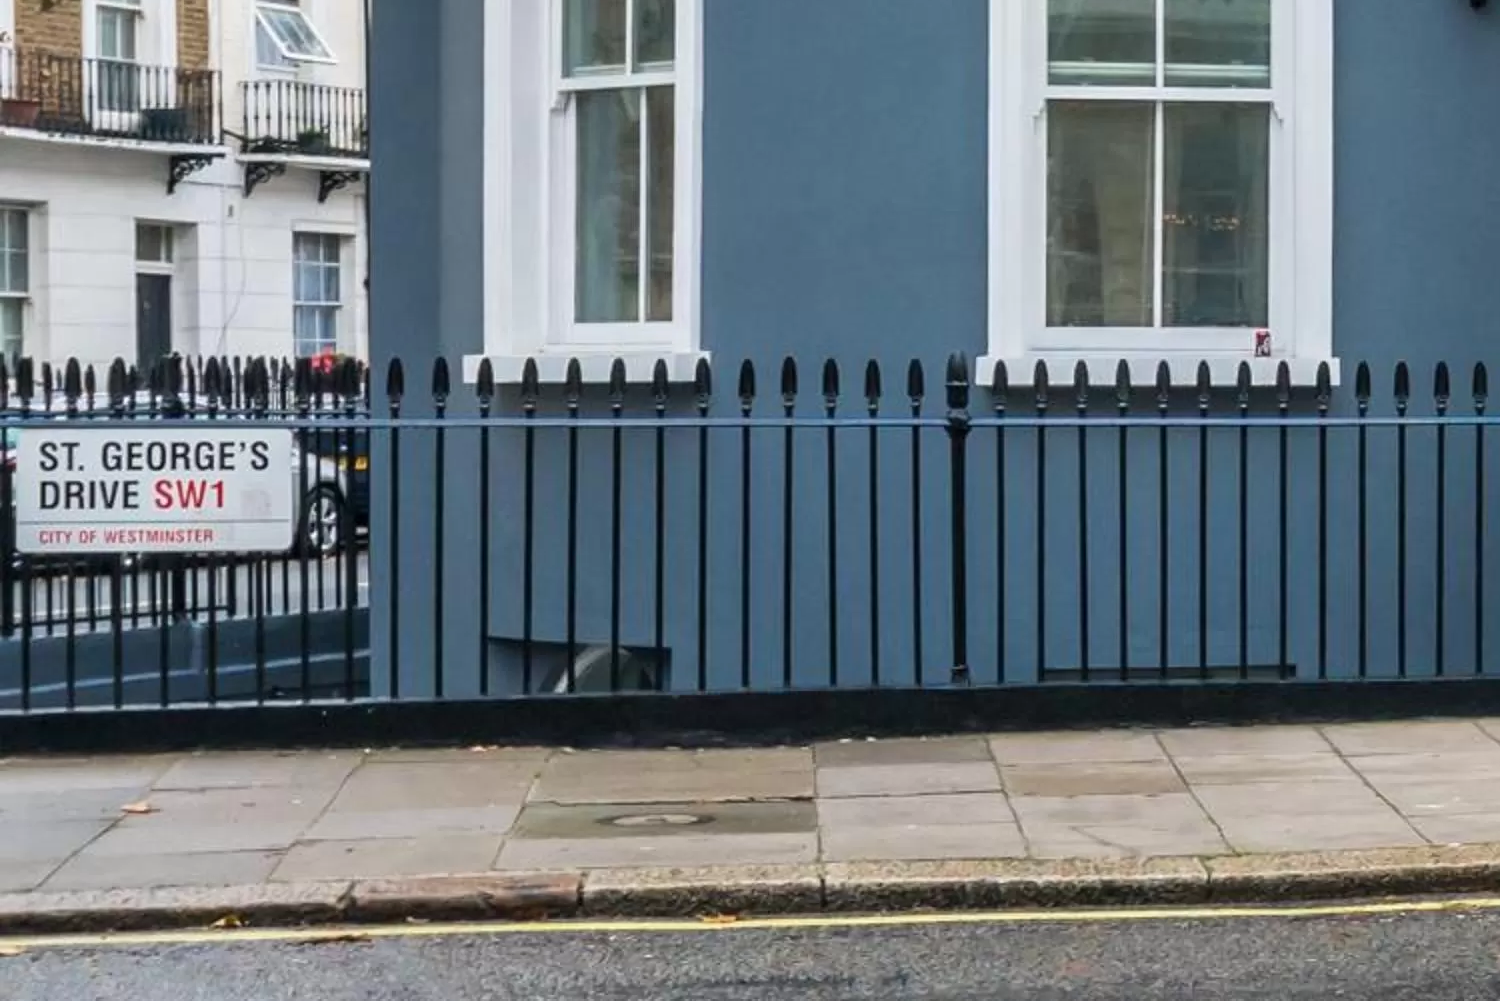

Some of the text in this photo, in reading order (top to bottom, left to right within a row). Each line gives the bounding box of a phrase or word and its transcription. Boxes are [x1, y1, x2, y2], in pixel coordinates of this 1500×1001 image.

[39, 441, 270, 472] ST. GEORGE'S
[39, 479, 225, 510] DRIVE SW1
[39, 528, 214, 545] CITY OF WESTMINSTER
